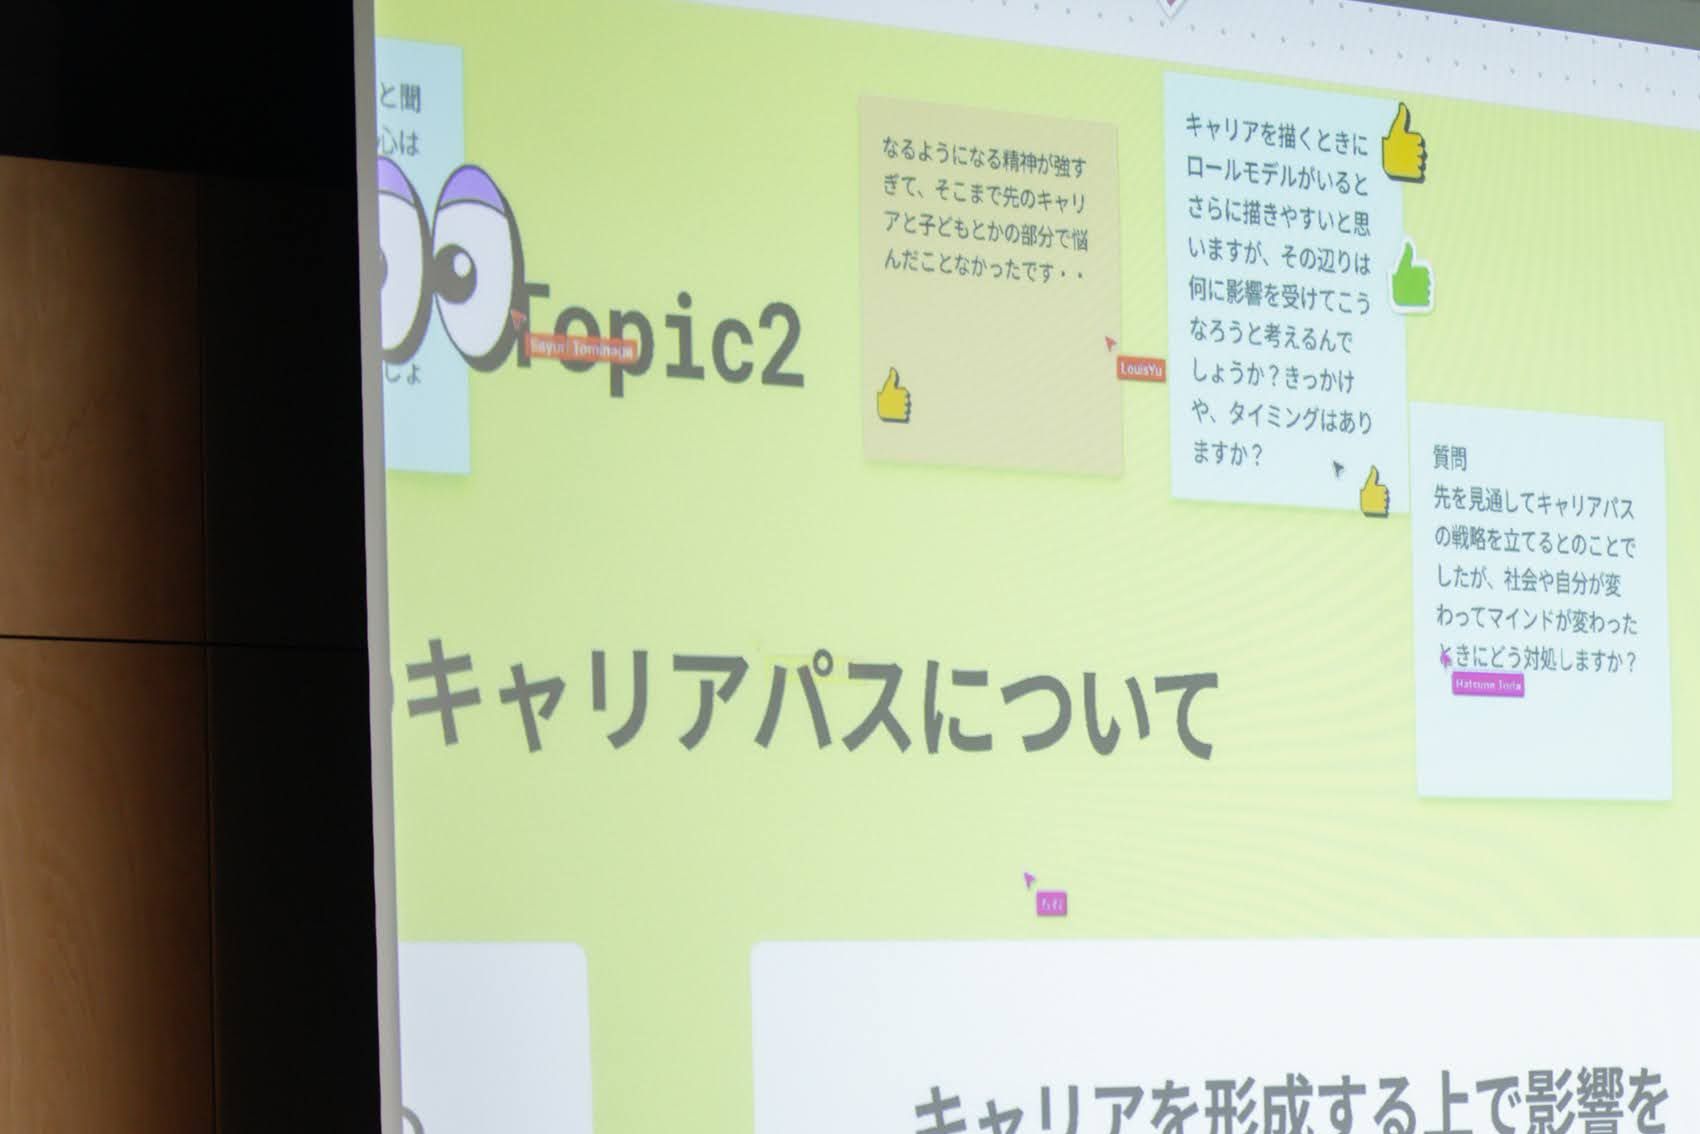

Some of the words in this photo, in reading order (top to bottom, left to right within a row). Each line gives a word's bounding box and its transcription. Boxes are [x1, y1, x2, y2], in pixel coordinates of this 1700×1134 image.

[1186, 112, 1368, 157] キャリアを描くときに
[883, 136, 1087, 178] なるようになる精神が強す
[1187, 155, 1369, 197] ロールモデルがいると
[884, 174, 1085, 214] ぎて、そこまで先のキャリ
[884, 210, 1088, 251] アと子どもとかの部分で悩
[1188, 196, 1371, 237] さらに描きやすいと思
[1189, 236, 1370, 275] いますが、その辺りは
[1189, 274, 1370, 315] 何に影響を受けてこう
[1190, 316, 1353, 353] なろうと考えるんで
[1192, 357, 1354, 393] しょうか？きっかけ
[1192, 398, 1372, 435] や、タイミングはあり
[1193, 439, 1263, 466] ますか？
[1433, 444, 1467, 472] 質問
[1434, 483, 1634, 520] 先を見通してキャリアパス
[1435, 525, 1636, 559] の戦略を立てるとのことで
[1437, 564, 1622, 598] したが、社会や自分が変
[1437, 603, 1638, 636] わってマインドが変わった
[406, 638, 1219, 761] キャリアパスについて
